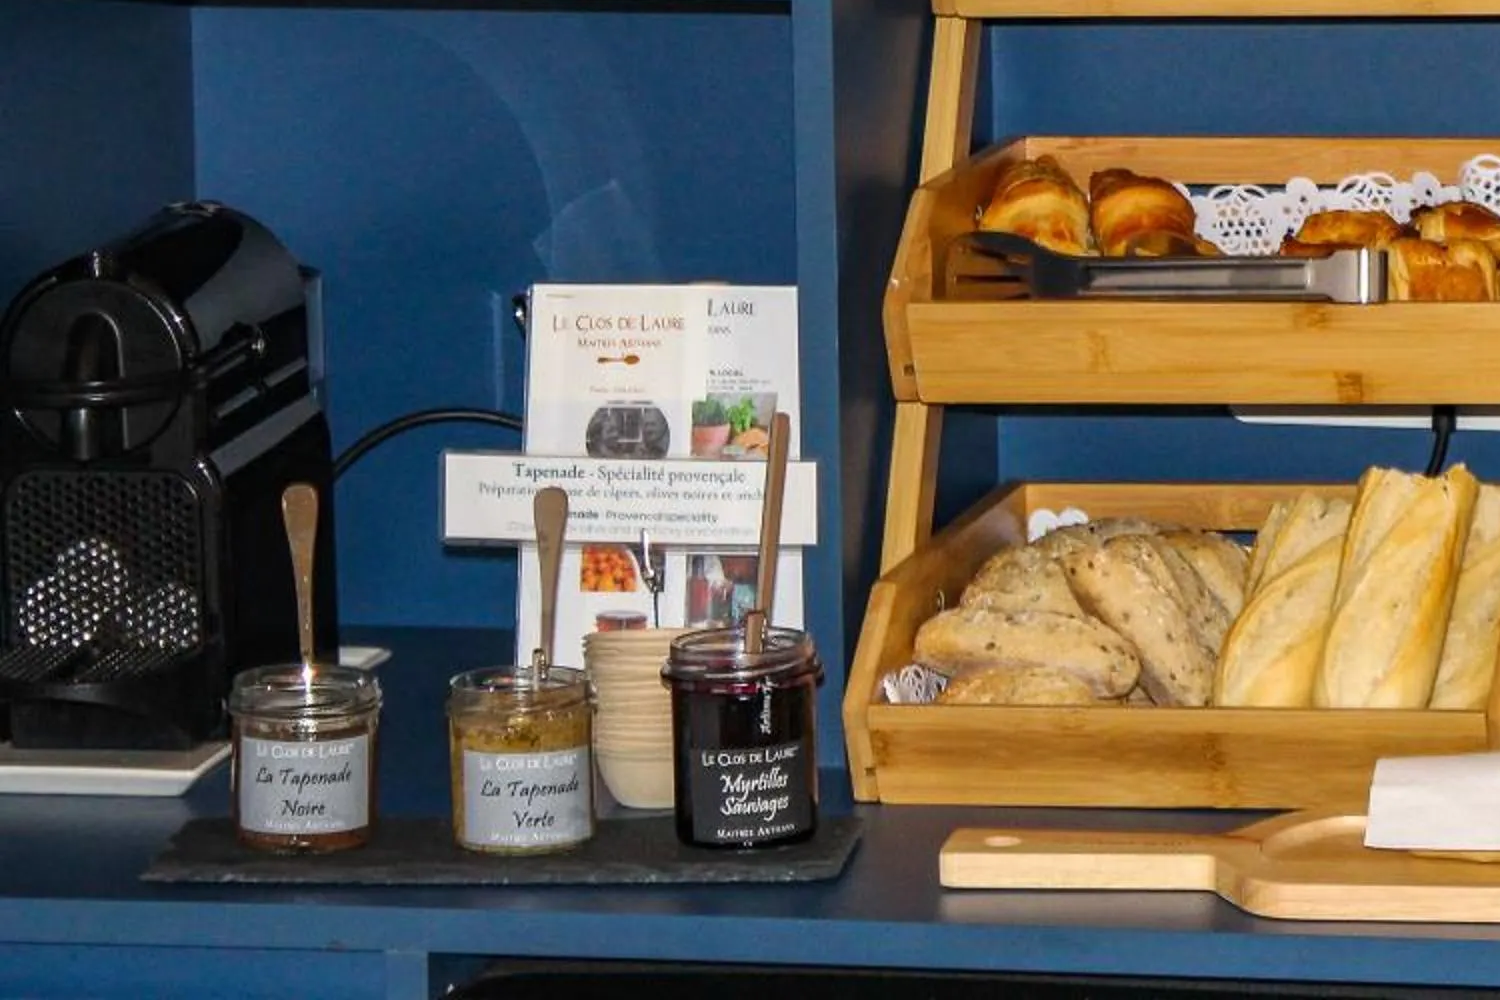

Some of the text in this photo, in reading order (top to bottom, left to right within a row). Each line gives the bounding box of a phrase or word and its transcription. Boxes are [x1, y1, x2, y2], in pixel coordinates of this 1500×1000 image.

[575, 311, 613, 334] CLOS
[641, 313, 685, 333] LAURE
[512, 461, 585, 483] Tapenade
[597, 464, 665, 487] Spécialité
[668, 466, 746, 488] provençale
[701, 748, 796, 767] LE CLOS DE LAURE
[255, 761, 353, 795] La Tapenade
[480, 771, 580, 807] La Tapenade
[719, 766, 789, 801] Myrtilles
[281, 799, 327, 818] Noire
[512, 809, 556, 829] Verte
[720, 795, 789, 822] Sauvages
